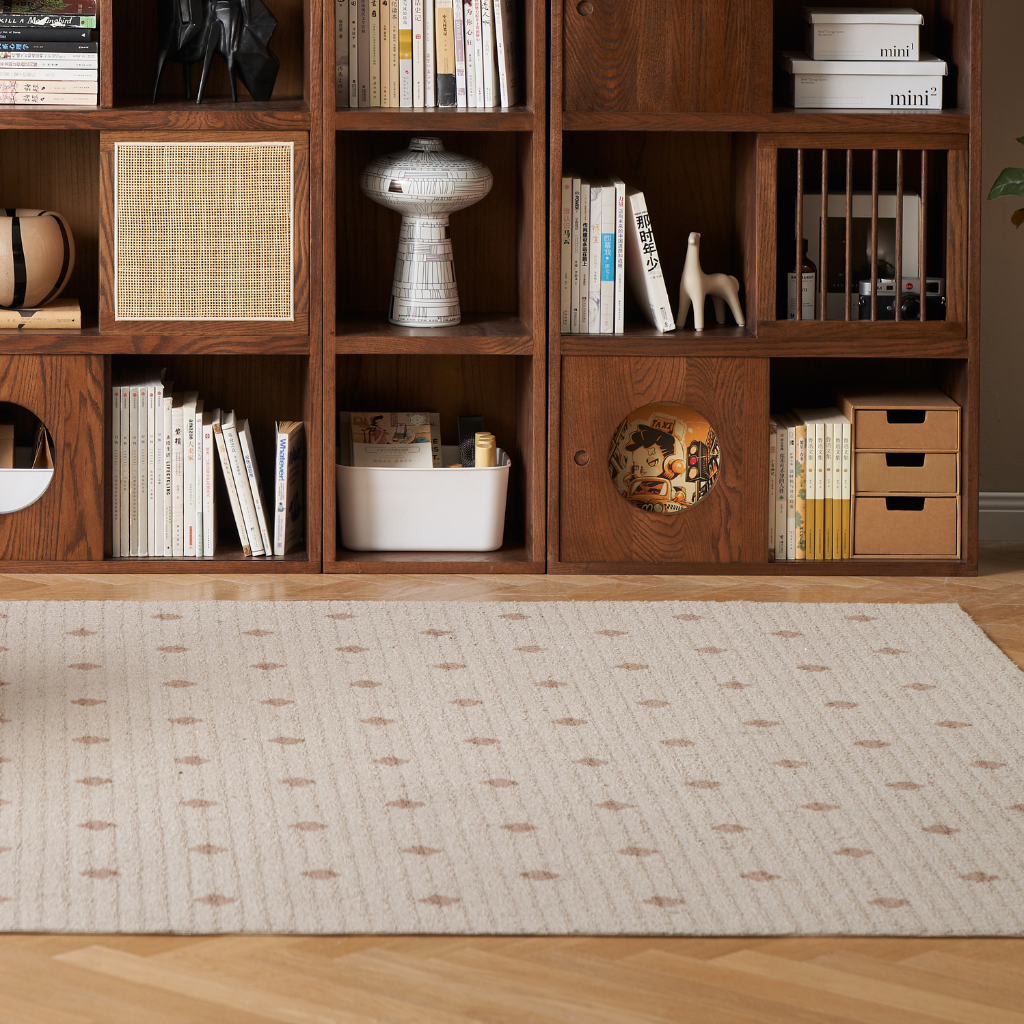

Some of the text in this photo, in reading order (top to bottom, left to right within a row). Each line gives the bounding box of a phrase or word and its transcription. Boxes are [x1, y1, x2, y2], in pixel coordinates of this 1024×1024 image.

[880, 45, 910, 57] mini
[890, 90, 929, 106] mini
[604, 234, 612, 257] 四幕戏
[636, 215, 660, 272] 那时年少
[651, 419, 674, 430] TAXI
[279, 438, 287, 481] Whatever!
